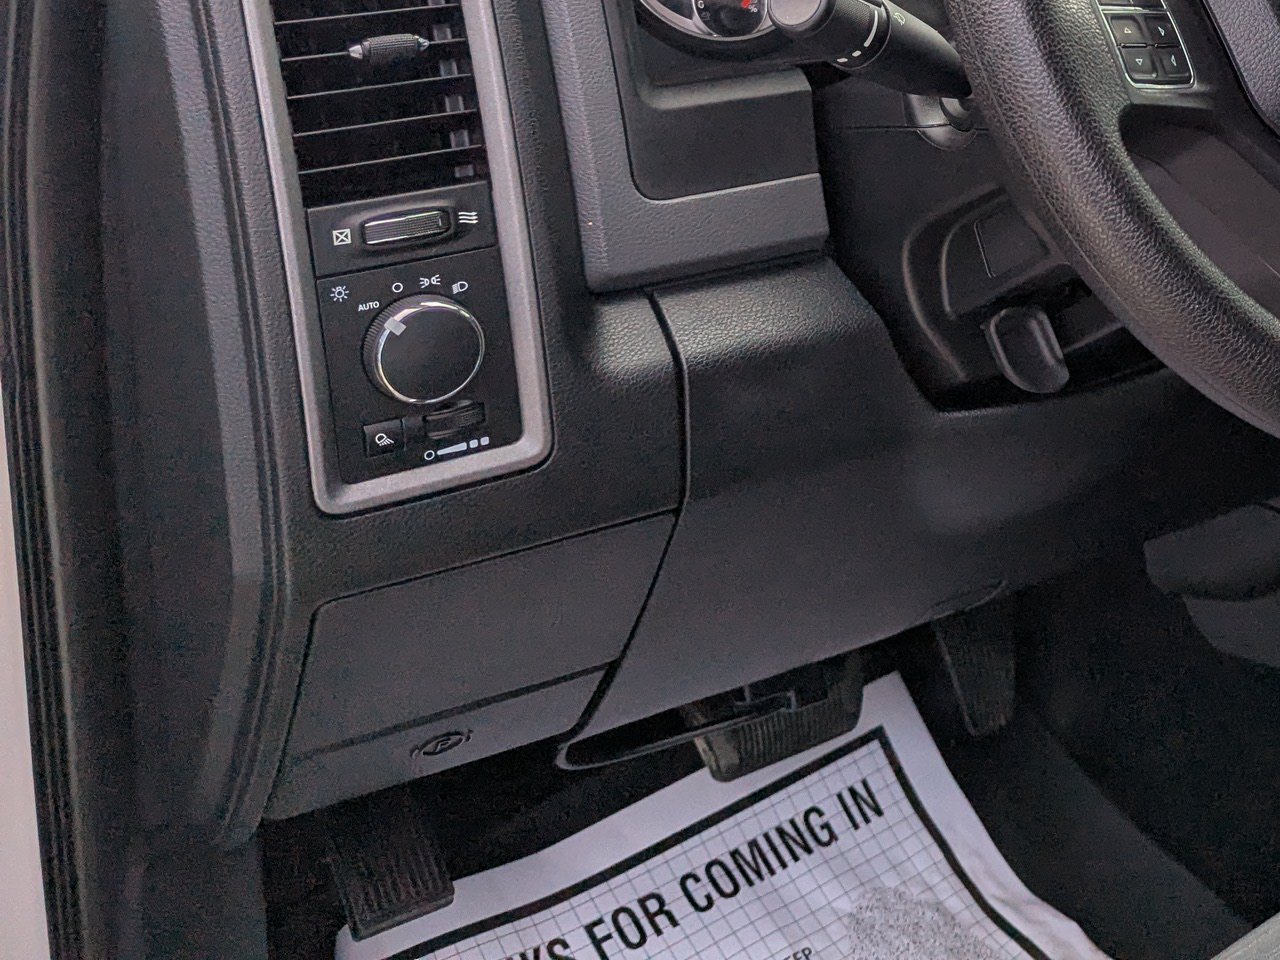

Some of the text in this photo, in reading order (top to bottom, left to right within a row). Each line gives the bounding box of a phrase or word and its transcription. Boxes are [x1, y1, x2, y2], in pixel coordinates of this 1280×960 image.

[358, 301, 380, 312] AUTO
[584, 778, 885, 960] FOR COMING IN
